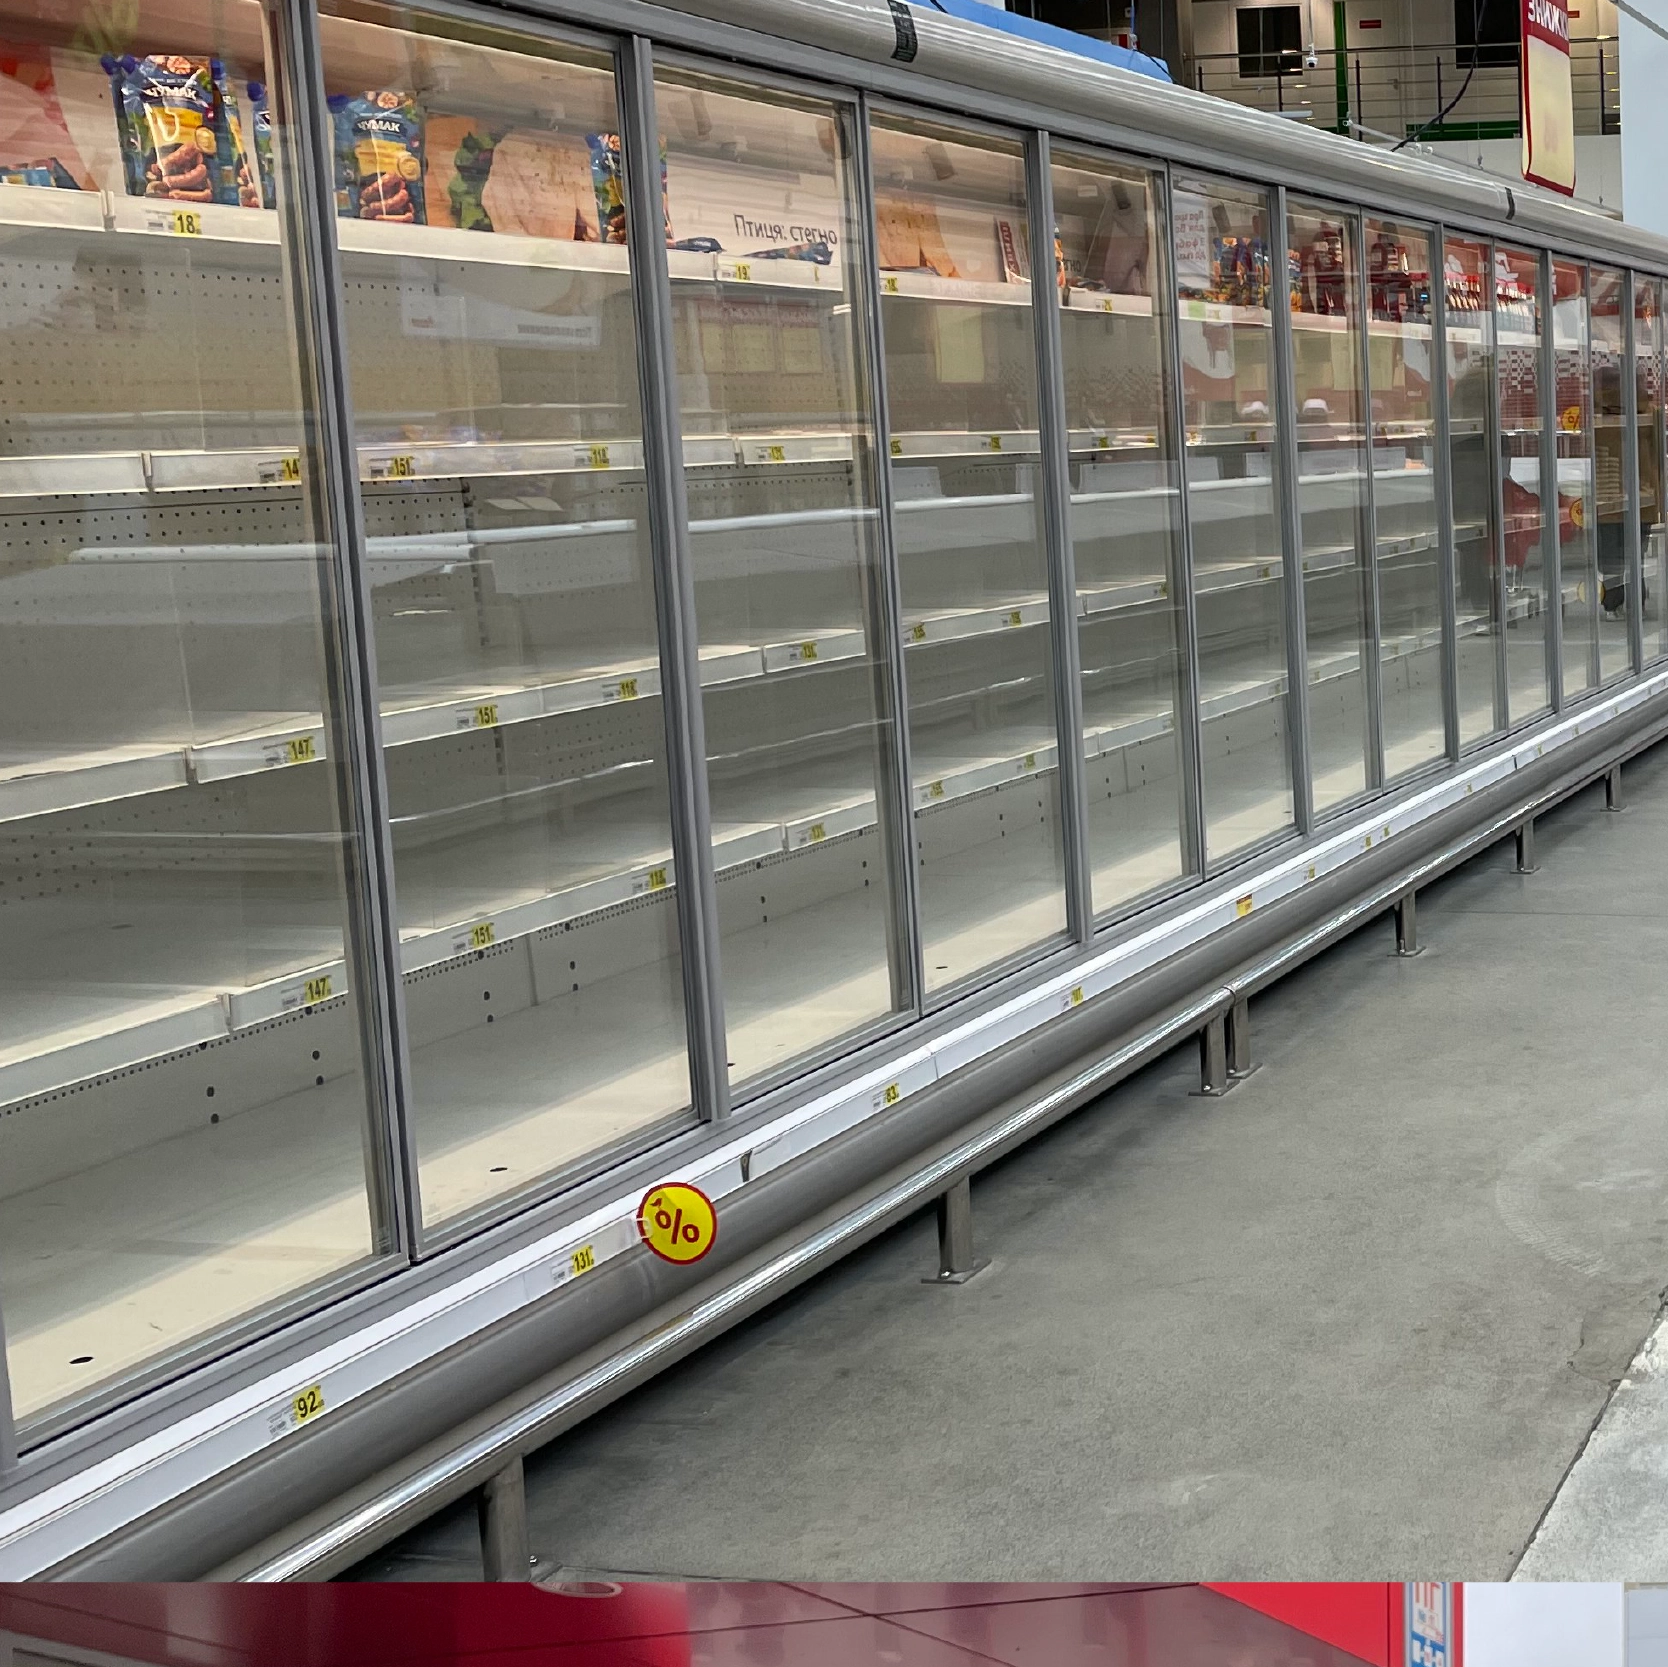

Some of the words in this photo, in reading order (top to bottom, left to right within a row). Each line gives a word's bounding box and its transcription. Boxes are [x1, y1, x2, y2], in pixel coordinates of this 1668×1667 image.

[358, 119, 400, 133] ЧУМАК
[177, 214, 196, 234] 18
[734, 214, 788, 244] Птиця:
[790, 226, 838, 245] стегно
[478, 706, 496, 725] 151
[474, 925, 491, 946] 151
[308, 977, 326, 1000] 147
[574, 1249, 591, 1271] 131
[298, 1391, 319, 1418] 92
